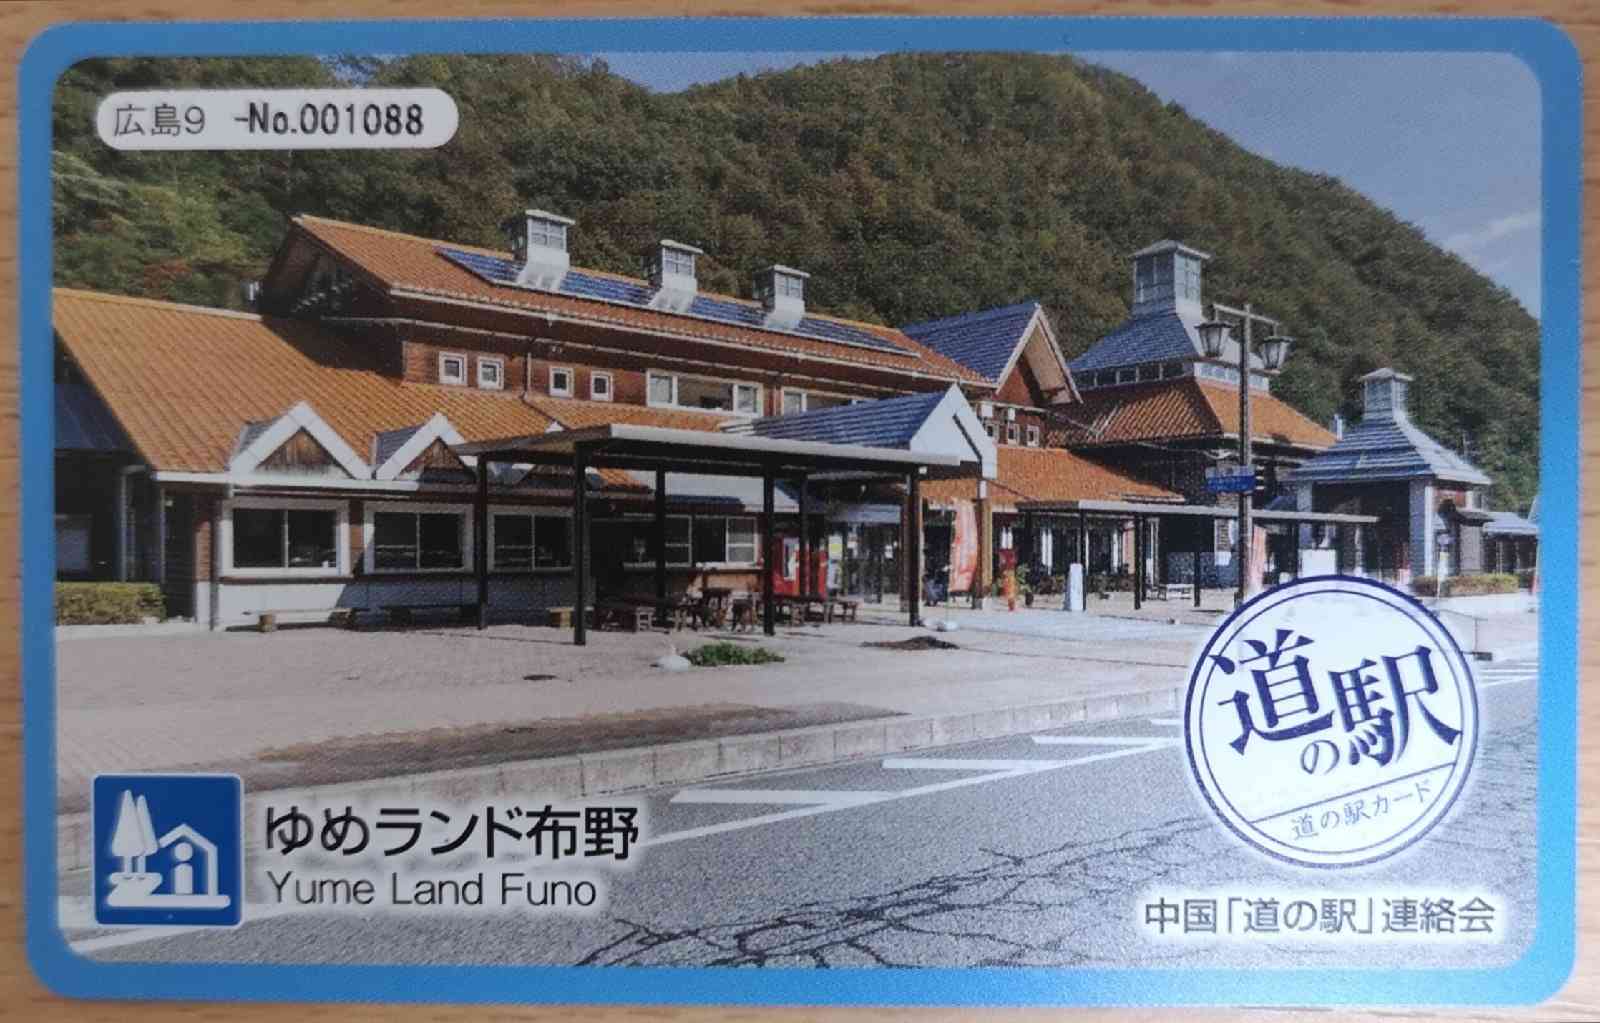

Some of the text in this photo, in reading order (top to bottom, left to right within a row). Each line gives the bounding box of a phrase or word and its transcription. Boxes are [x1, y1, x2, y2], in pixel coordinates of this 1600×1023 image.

[113, 103, 206, 136] 広島9
[1209, 629, 1463, 775] 道の駅
[266, 805, 640, 860] ゆめランド布野
[1291, 781, 1432, 841] 道の駅カード
[266, 870, 598, 906] Yume Land Funo
[1144, 896, 1496, 935] 中国「道の駅」連絡会
